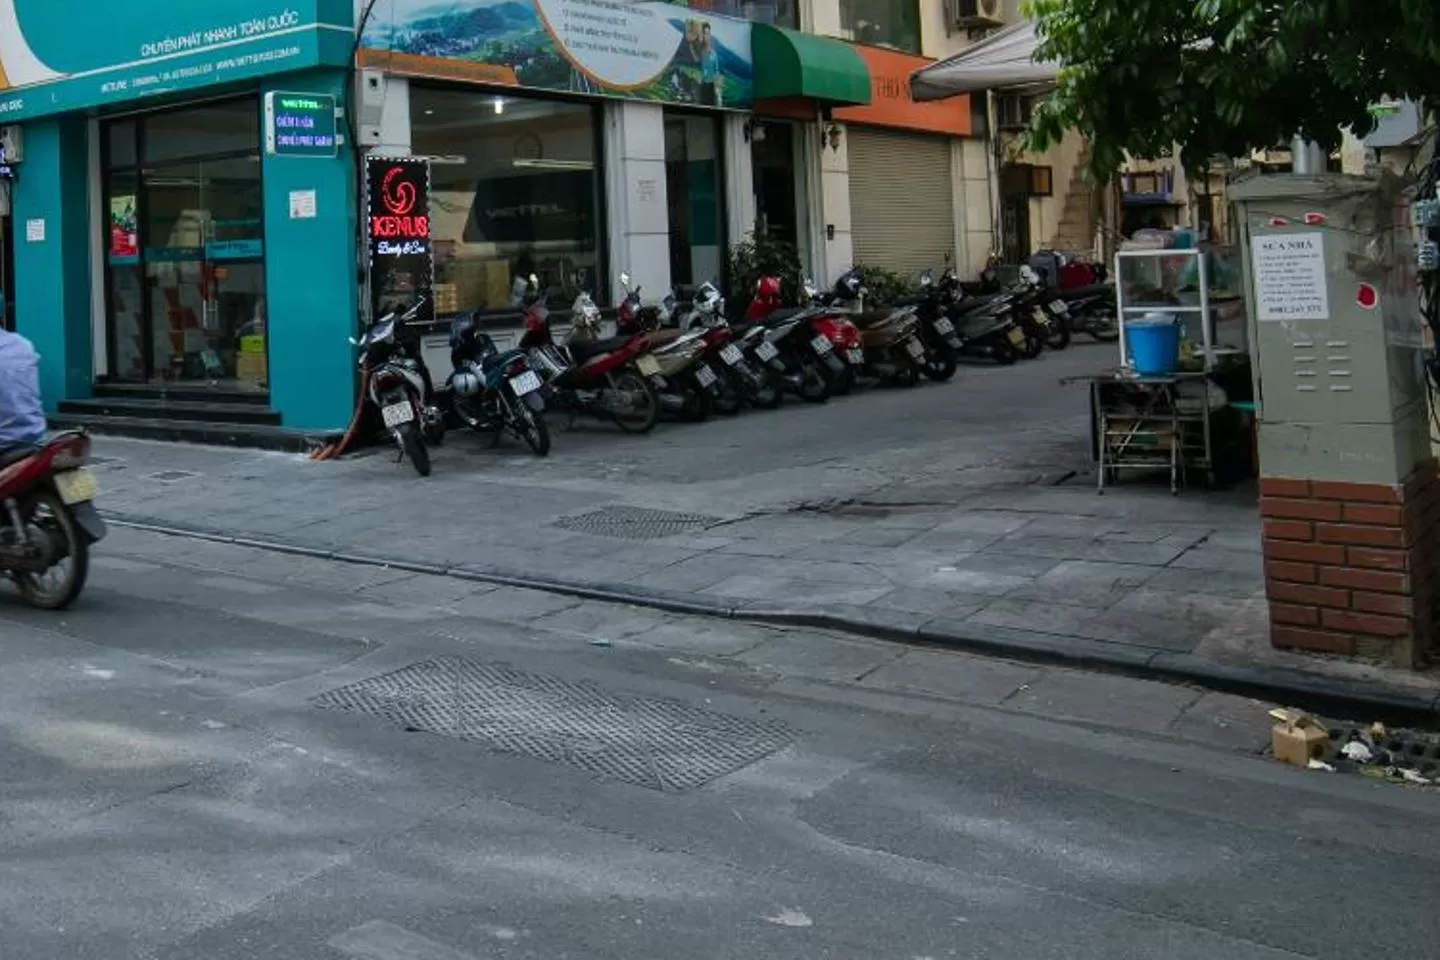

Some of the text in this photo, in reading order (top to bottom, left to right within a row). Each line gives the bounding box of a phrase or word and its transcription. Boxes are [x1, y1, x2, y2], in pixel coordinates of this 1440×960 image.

[203, 25, 237, 43] NHANH
[267, 8, 299, 29] QUỐC
[372, 216, 428, 237] KENUS
